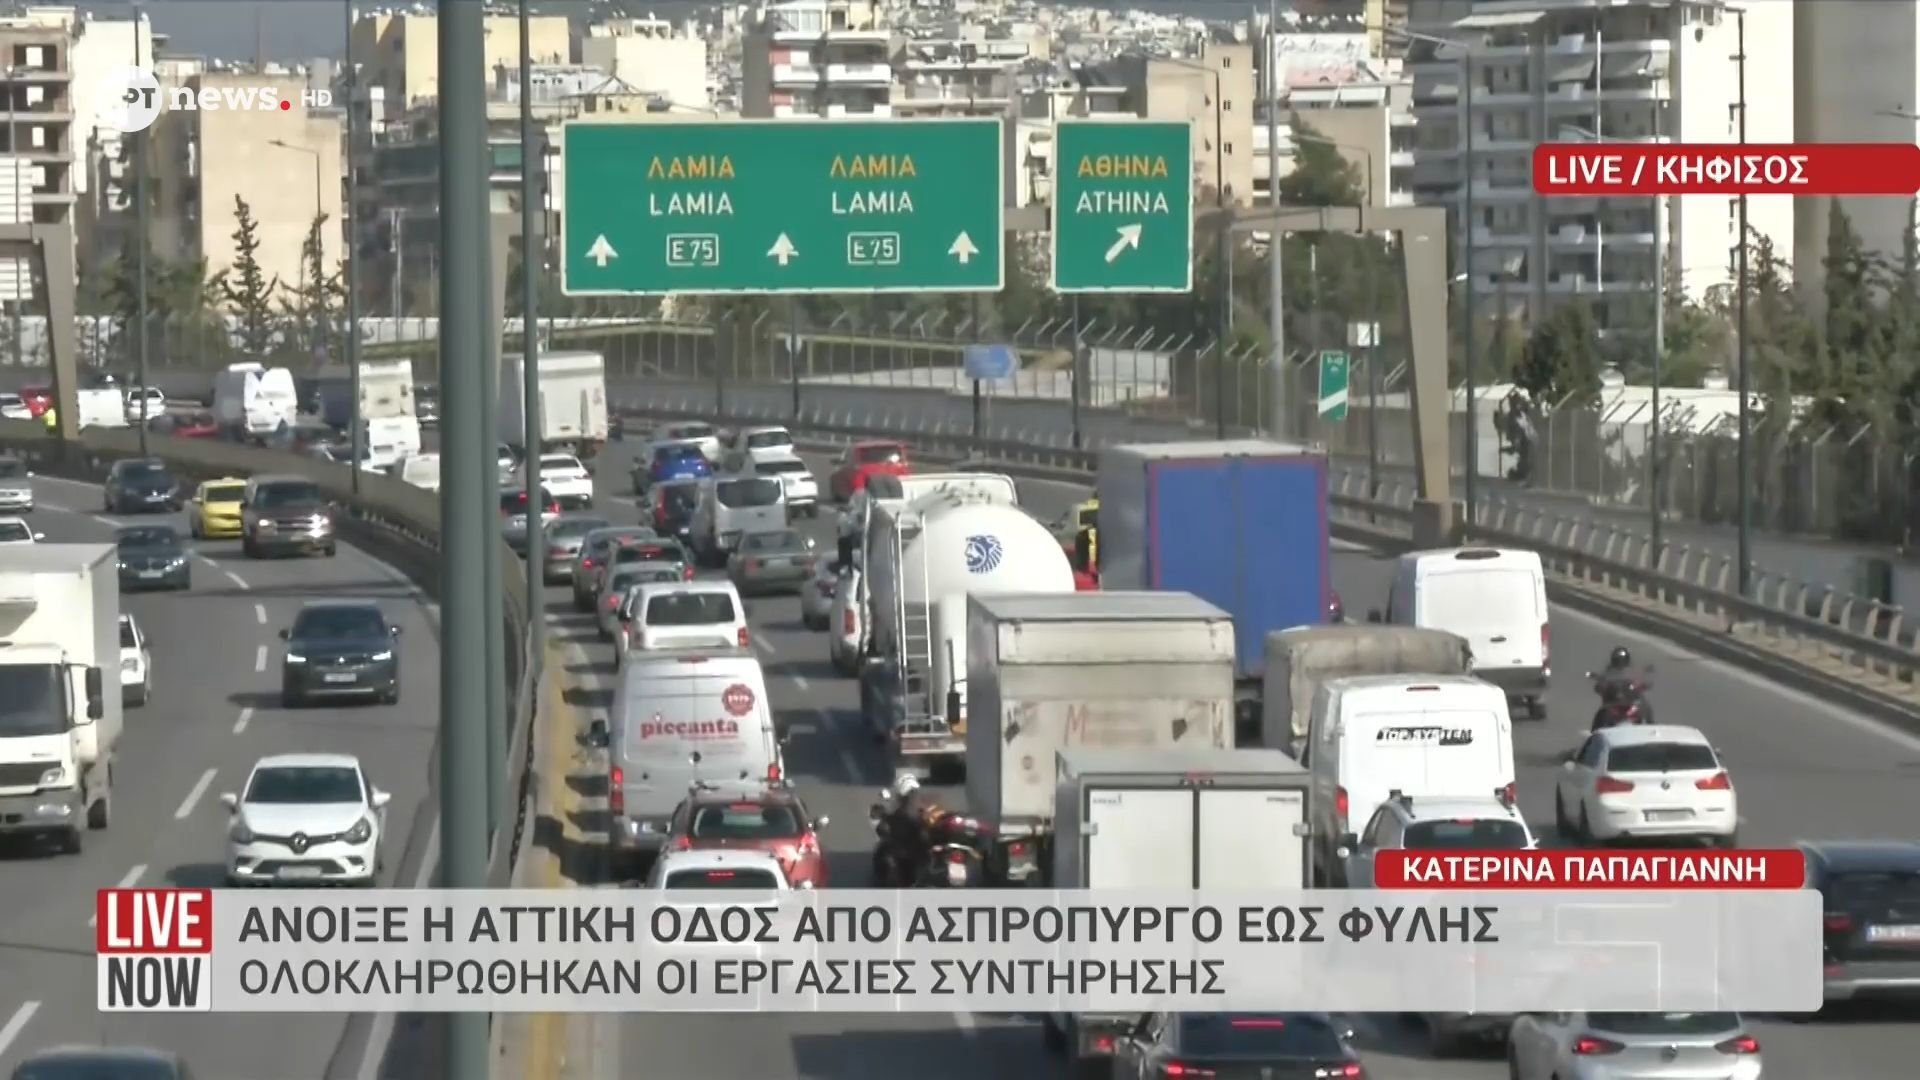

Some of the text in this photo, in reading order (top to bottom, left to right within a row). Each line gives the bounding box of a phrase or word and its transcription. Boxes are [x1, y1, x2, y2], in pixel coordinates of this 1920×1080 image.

[647, 155, 736, 180] ΛΑΜΙΑ
[829, 153, 917, 179] ΛΑΜΙΑ
[1077, 154, 1169, 179] ΑΘΗΝΑ
[649, 191, 734, 216] LAMIA
[831, 190, 914, 215] LAMIA
[1076, 190, 1169, 215] ATHINA
[641, 717, 739, 738] piccanta
